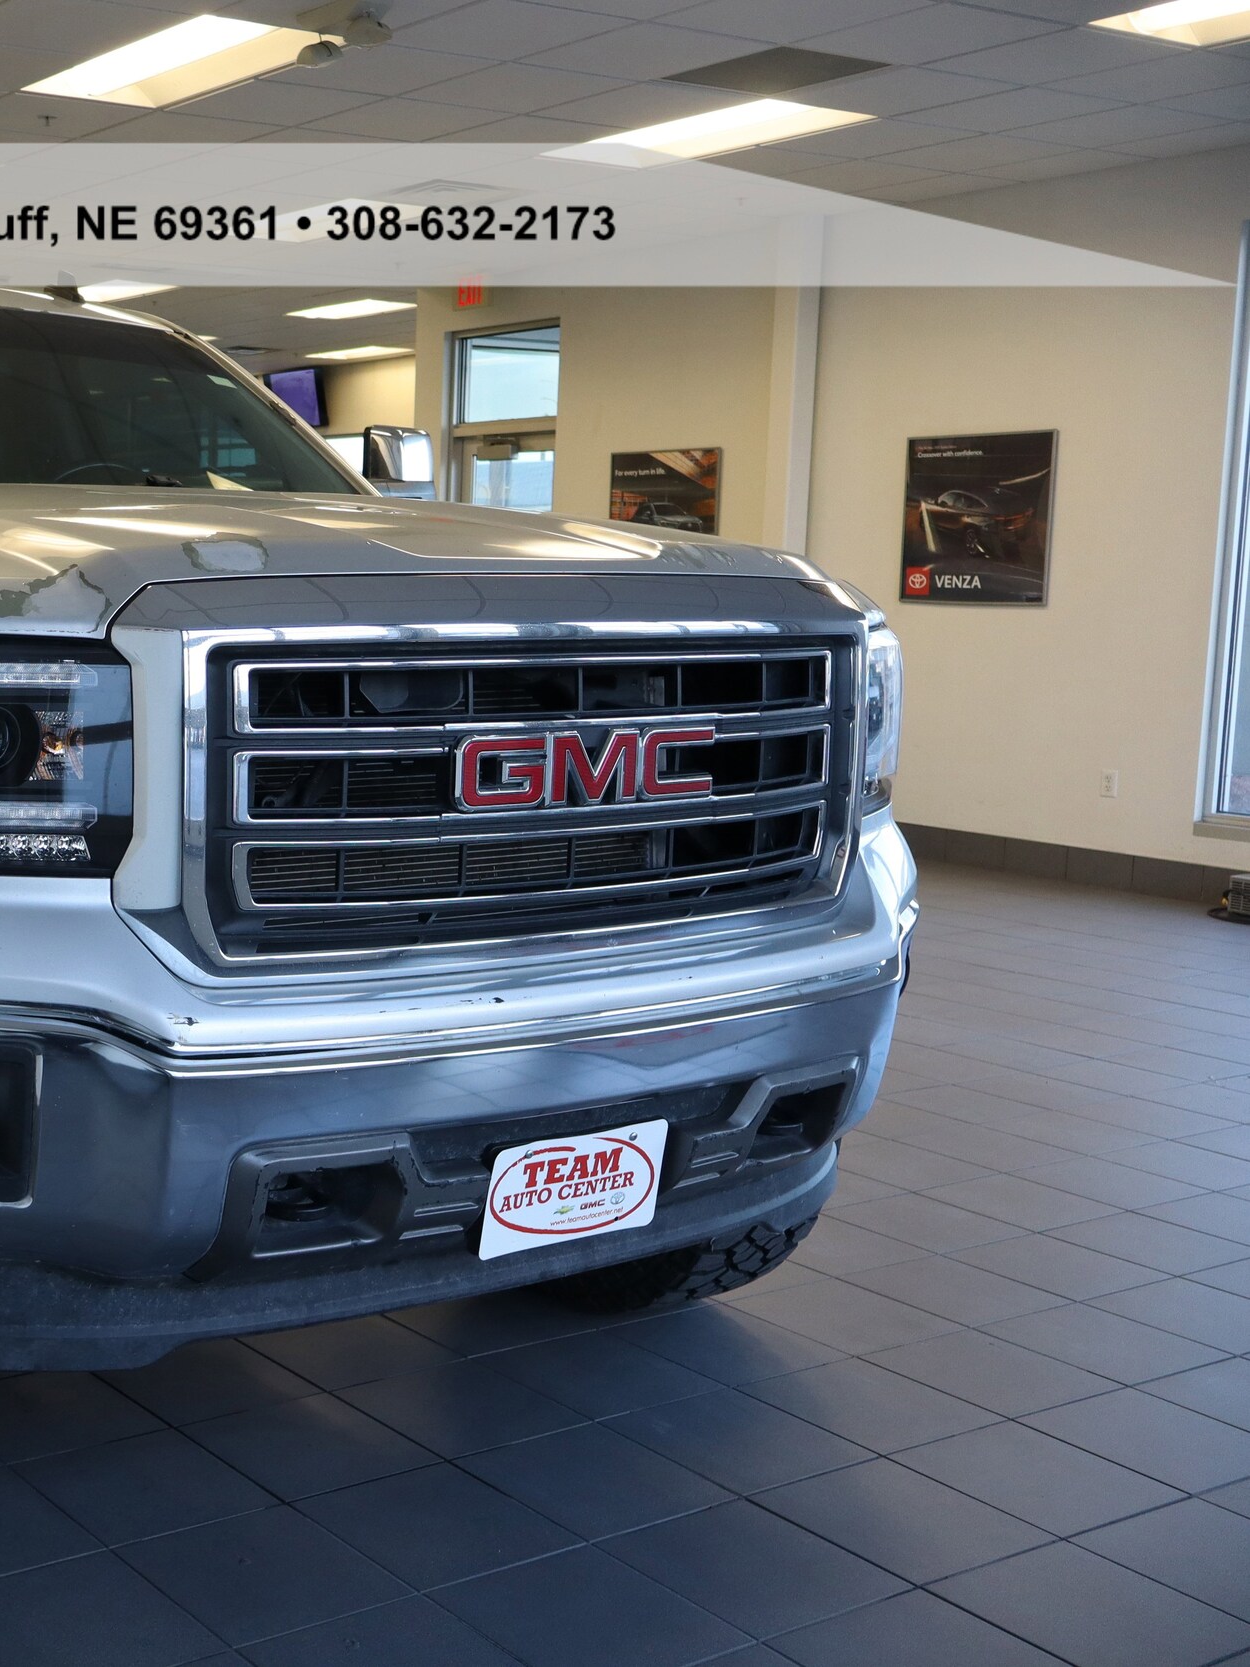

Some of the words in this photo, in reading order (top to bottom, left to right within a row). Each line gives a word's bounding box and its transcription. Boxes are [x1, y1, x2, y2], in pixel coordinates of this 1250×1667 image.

[935, 574, 981, 589] VENZA
[454, 726, 716, 813] GMC
[523, 1147, 624, 1188] TEAM
[499, 1187, 551, 1214] AUTO
[557, 1171, 635, 1200] CENTER
[580, 1199, 606, 1210] GMC
[550, 1206, 624, 1227] www.teamautocenter.net
